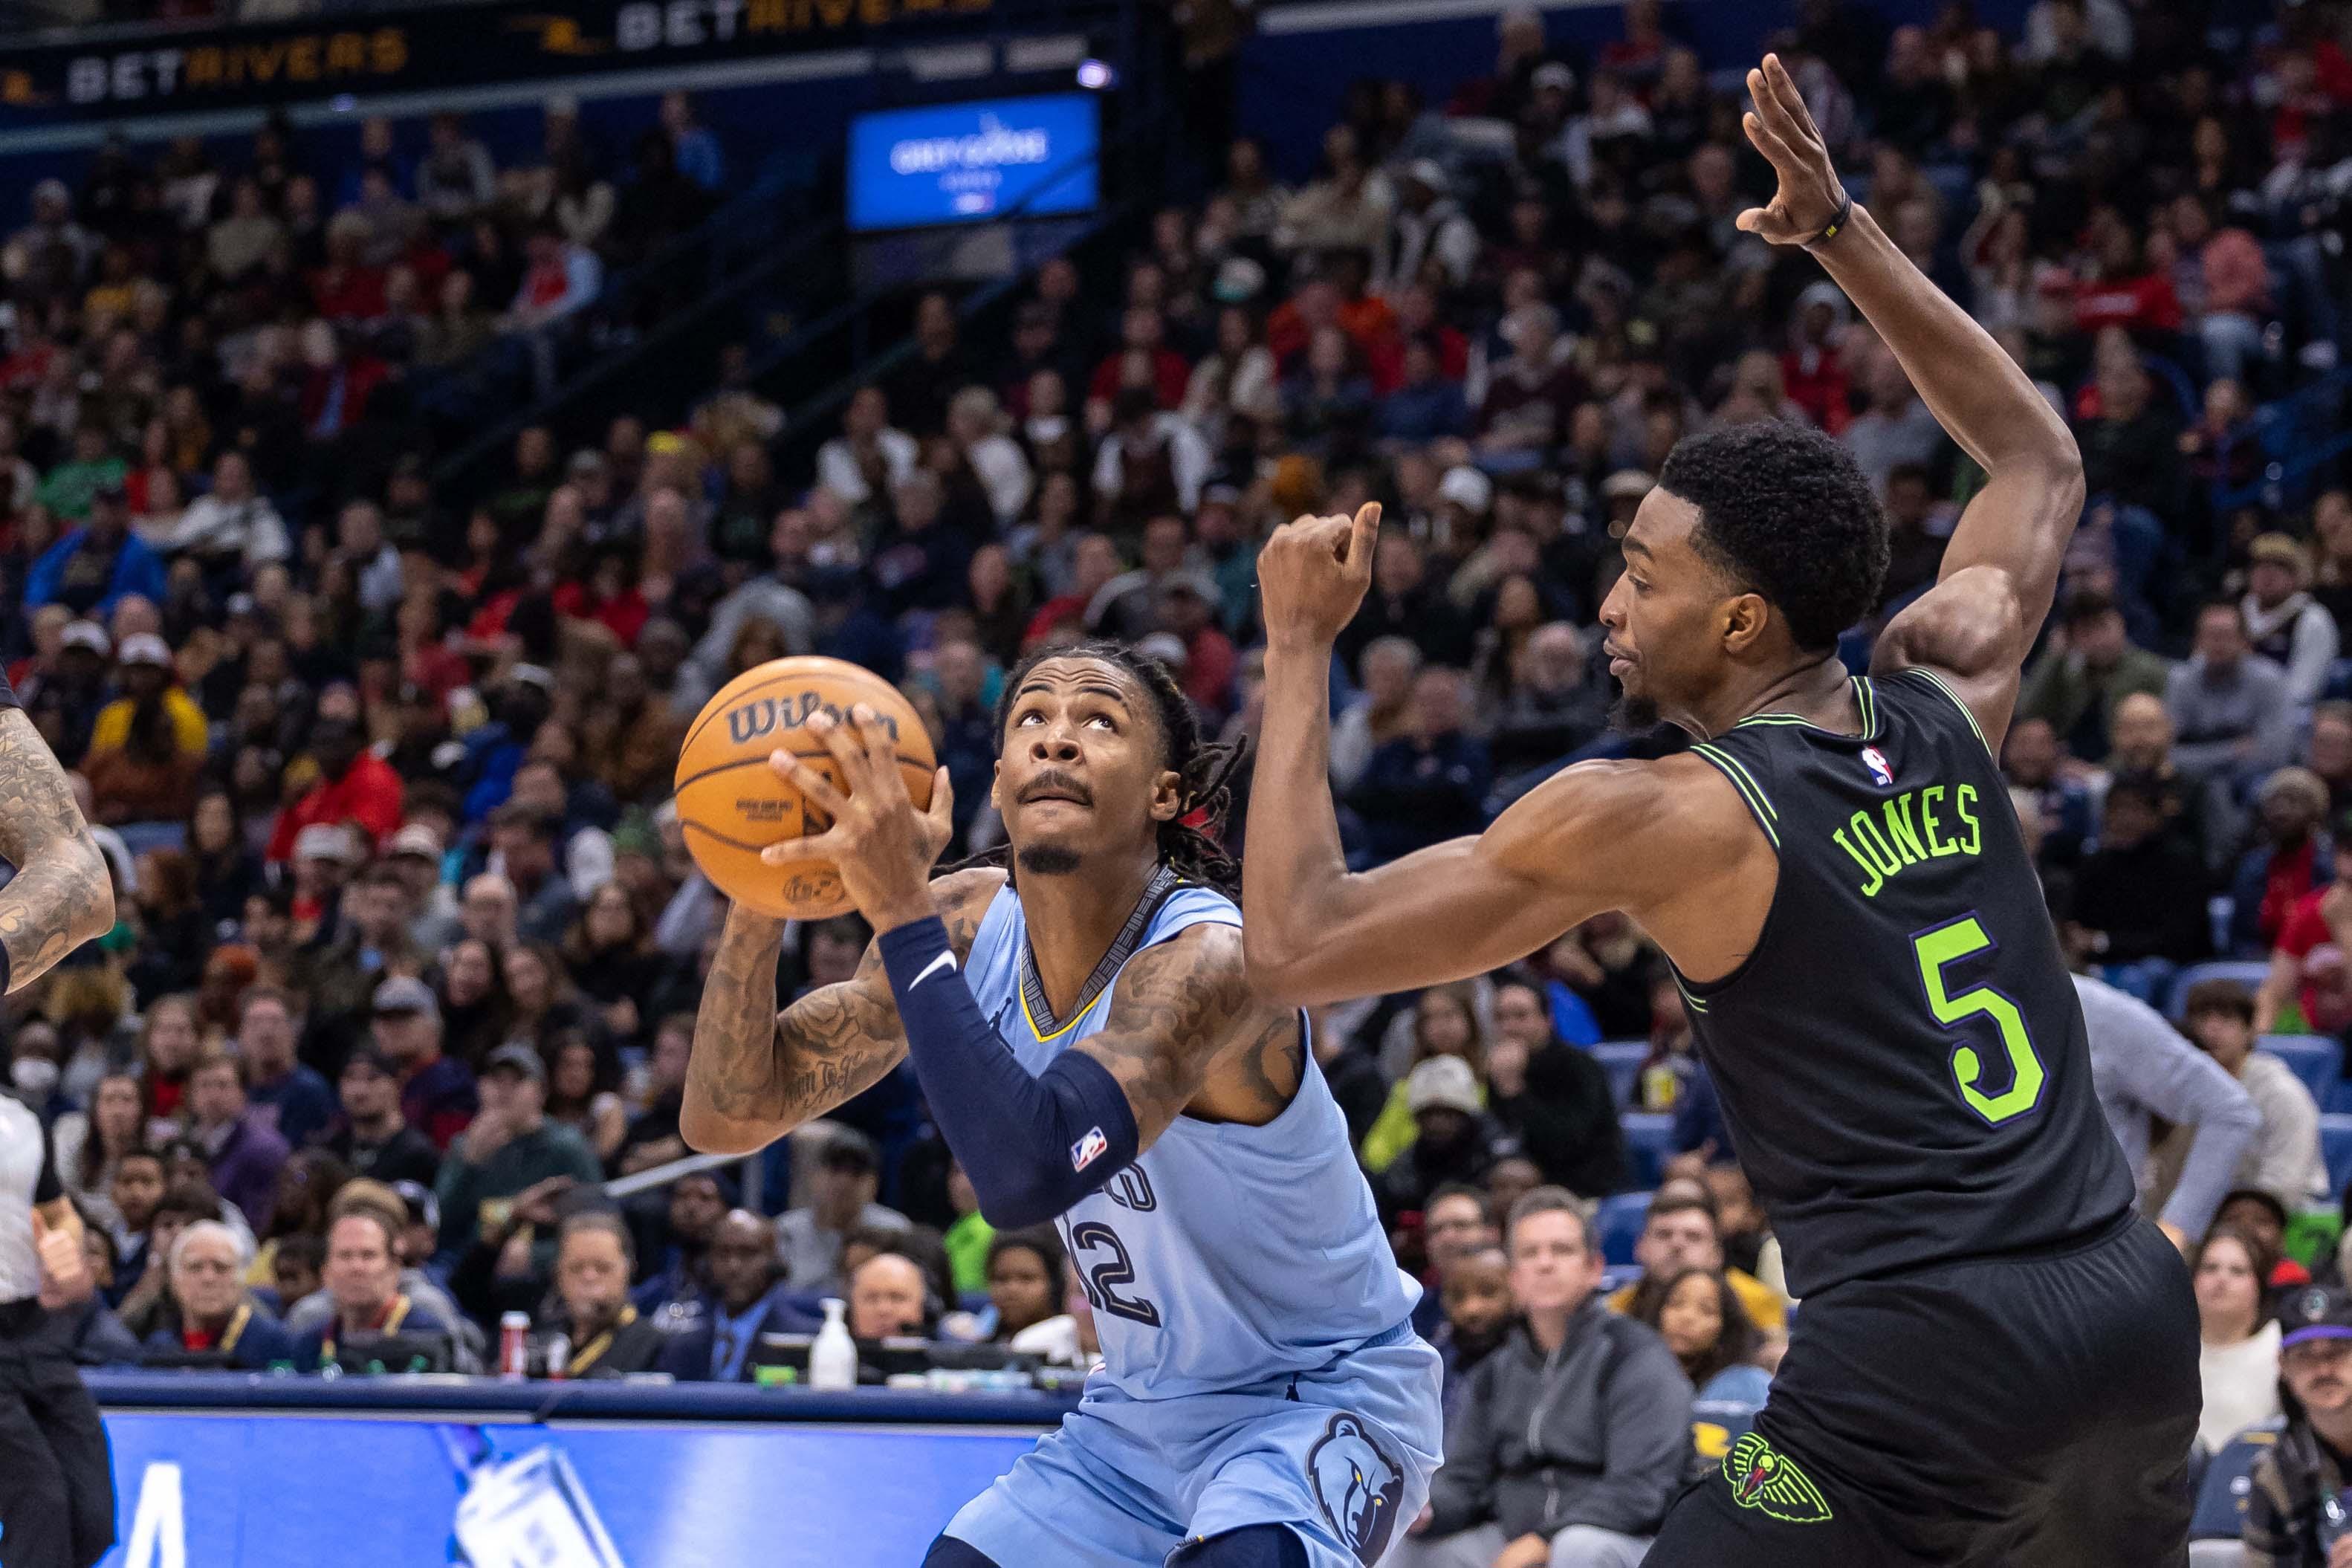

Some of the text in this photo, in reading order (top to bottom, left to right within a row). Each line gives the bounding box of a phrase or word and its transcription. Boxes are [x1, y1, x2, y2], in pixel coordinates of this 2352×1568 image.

[615, 0, 993, 50] BETRIVE
[1833, 784, 1981, 896] JONES
[1910, 911, 2048, 1127] 5
